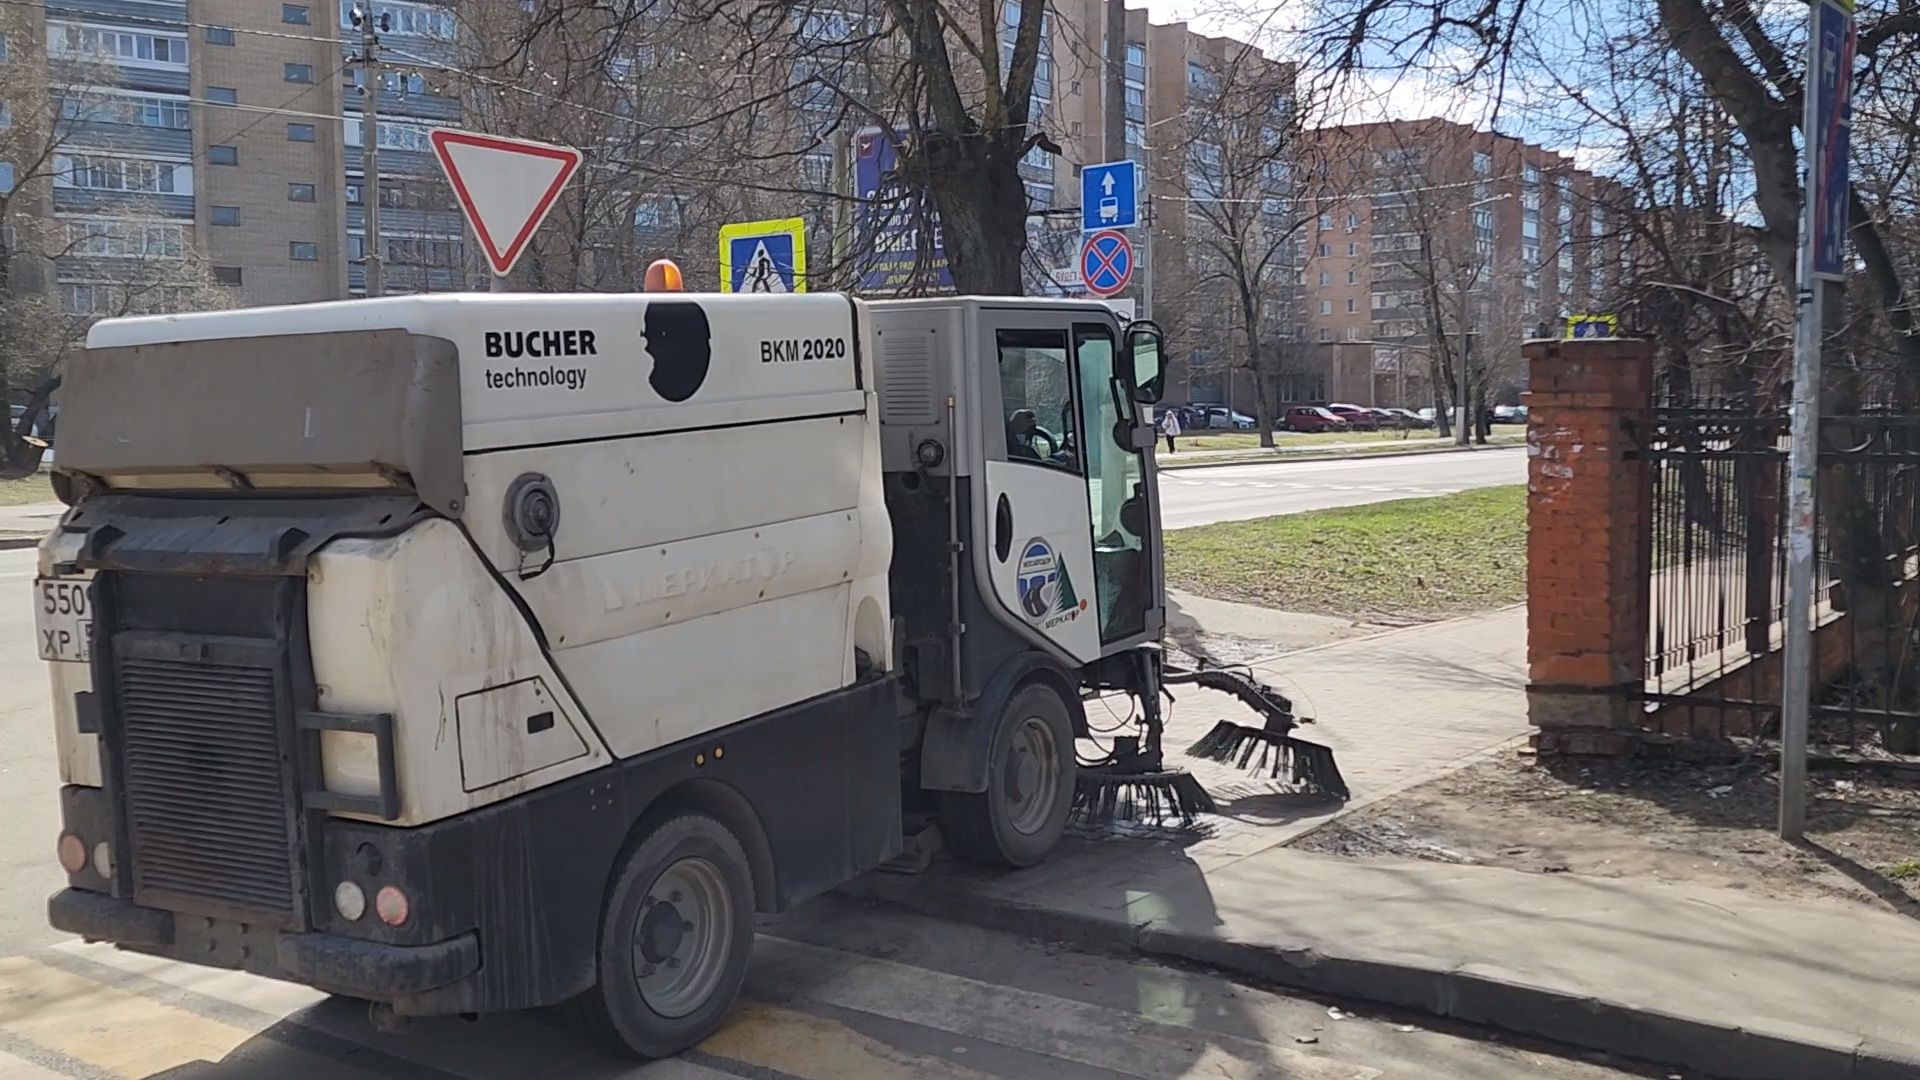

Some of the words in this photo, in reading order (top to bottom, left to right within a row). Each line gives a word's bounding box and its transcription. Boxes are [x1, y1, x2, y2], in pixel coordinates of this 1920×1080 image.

[485, 330, 597, 358] BUCHER
[802, 337, 845, 360] 2020
[485, 365, 587, 390] technology
